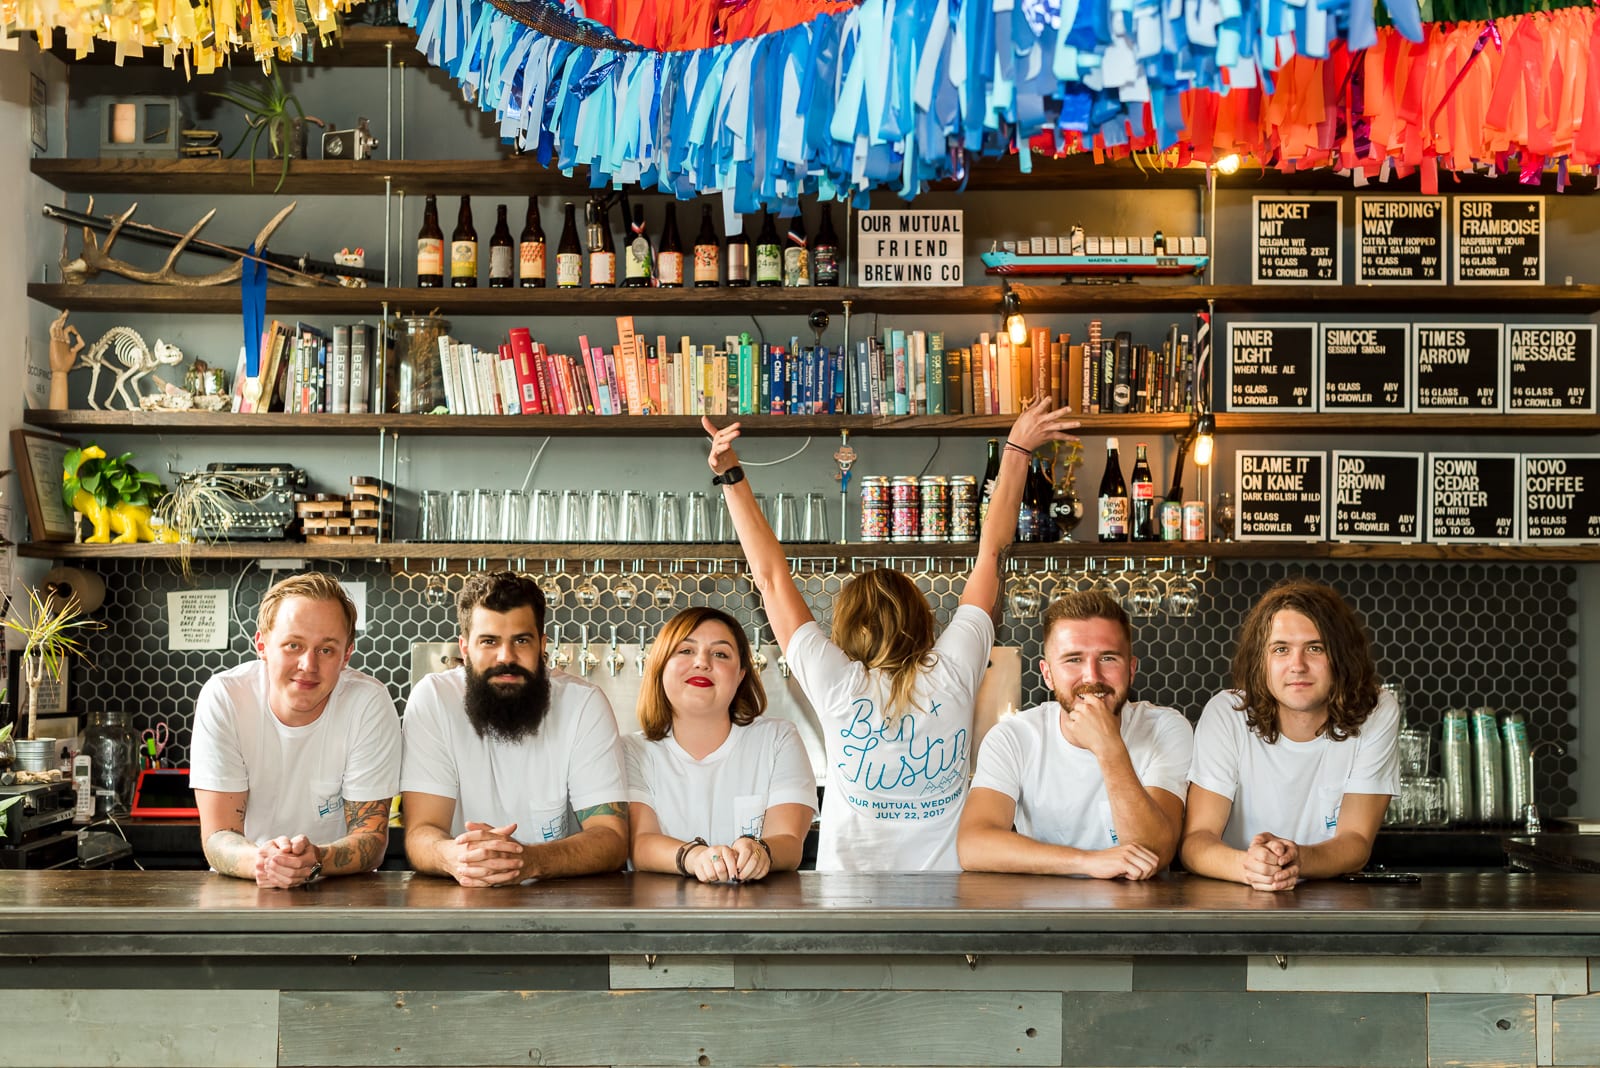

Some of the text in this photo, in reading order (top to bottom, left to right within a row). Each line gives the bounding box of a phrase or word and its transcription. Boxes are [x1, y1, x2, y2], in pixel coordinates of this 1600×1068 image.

[1261, 203, 1310, 219] WICKET
[1364, 203, 1434, 218] WEIRDING
[1462, 203, 1492, 217] SUR
[861, 216, 960, 232] OUR MUTUAL
[1260, 221, 1284, 236] WIT
[1364, 220, 1394, 235] WAY
[1463, 220, 1540, 235] FRAMBOISE
[878, 240, 947, 256] FRIEND
[1260, 238, 1289, 246] BELGIAN
[1260, 247, 1329, 256] WITH CITRUS ZEST
[1363, 246, 1388, 254] BRETT
[1461, 246, 1512, 254] BELGIAN WIT
[1318, 258, 1332, 266] ABV
[1472, 257, 1496, 265] GLASS
[1523, 257, 1538, 265] ABV
[865, 265, 960, 281] BREWING CO
[1276, 269, 1308, 277] CROWLER
[1378, 268, 1413, 276] CROWLER
[1475, 268, 1510, 276] CROWLER
[1234, 330, 1273, 346] INNER
[1328, 330, 1377, 345] SIMCOE
[1420, 330, 1465, 346] TIMES
[1512, 331, 1576, 346] ARECIBO
[1234, 347, 1272, 363] LIGHT
[1328, 346, 1386, 354] SESSION SMASH
[1419, 348, 1470, 364] ARROW
[1512, 346, 1576, 361] MESSAGE
[336, 355, 345, 387] BEER
[353, 354, 362, 387] BEER
[1234, 366, 1295, 374] WHEAT PALE ALE
[1420, 364, 1432, 373] IPA
[1514, 363, 1526, 372] IPA
[1245, 385, 1268, 393] GLASS
[1293, 387, 1308, 396] ABV
[1338, 383, 1360, 391] GLASS
[1384, 383, 1398, 391] ABV
[1431, 388, 1458, 396] GLASS
[1477, 388, 1494, 397] ABV
[1525, 388, 1553, 396] GLASS
[1568, 388, 1585, 396] ABV
[1244, 396, 1278, 405] CROWLER
[1337, 394, 1372, 402] CROWLER
[1431, 397, 1469, 405] CROWLER
[1524, 398, 1562, 407] CROWLER
[1243, 457, 1310, 473] BLAME IT
[1339, 459, 1365, 473] DAD
[1435, 460, 1477, 475] SOWN
[1527, 460, 1566, 475] NOVO
[1242, 474, 1303, 490] ON KANE
[1338, 474, 1386, 490] BROWN
[1434, 476, 1479, 491] CEDAR
[1527, 477, 1584, 492] COFFEE
[1242, 492, 1320, 501] DARK ENGLISH MILD
[1337, 490, 1362, 504] ALE
[1434, 491, 1488, 507] PORTER
[1528, 494, 1576, 510] STOUT
[1254, 512, 1279, 521] GLASS
[1304, 515, 1320, 523] ABV
[1351, 512, 1376, 520] GLASS
[1398, 515, 1414, 523] ABV
[1446, 518, 1470, 526] GLASS
[1496, 518, 1511, 526] ABV
[1541, 516, 1567, 524] GLASS
[1253, 523, 1292, 532] CROWLER
[1354, 522, 1389, 531] CROWLER
[1435, 527, 1447, 535] NO
[1529, 528, 1540, 536] NO
[1543, 528, 1552, 536] TO
[1554, 528, 1565, 536] GO
[841, 699, 914, 742] Ben
[838, 728, 966, 790] Justin
[849, 795, 868, 808] OUR
[921, 787, 963, 809] WEDDING
[923, 808, 945, 818] 2017
